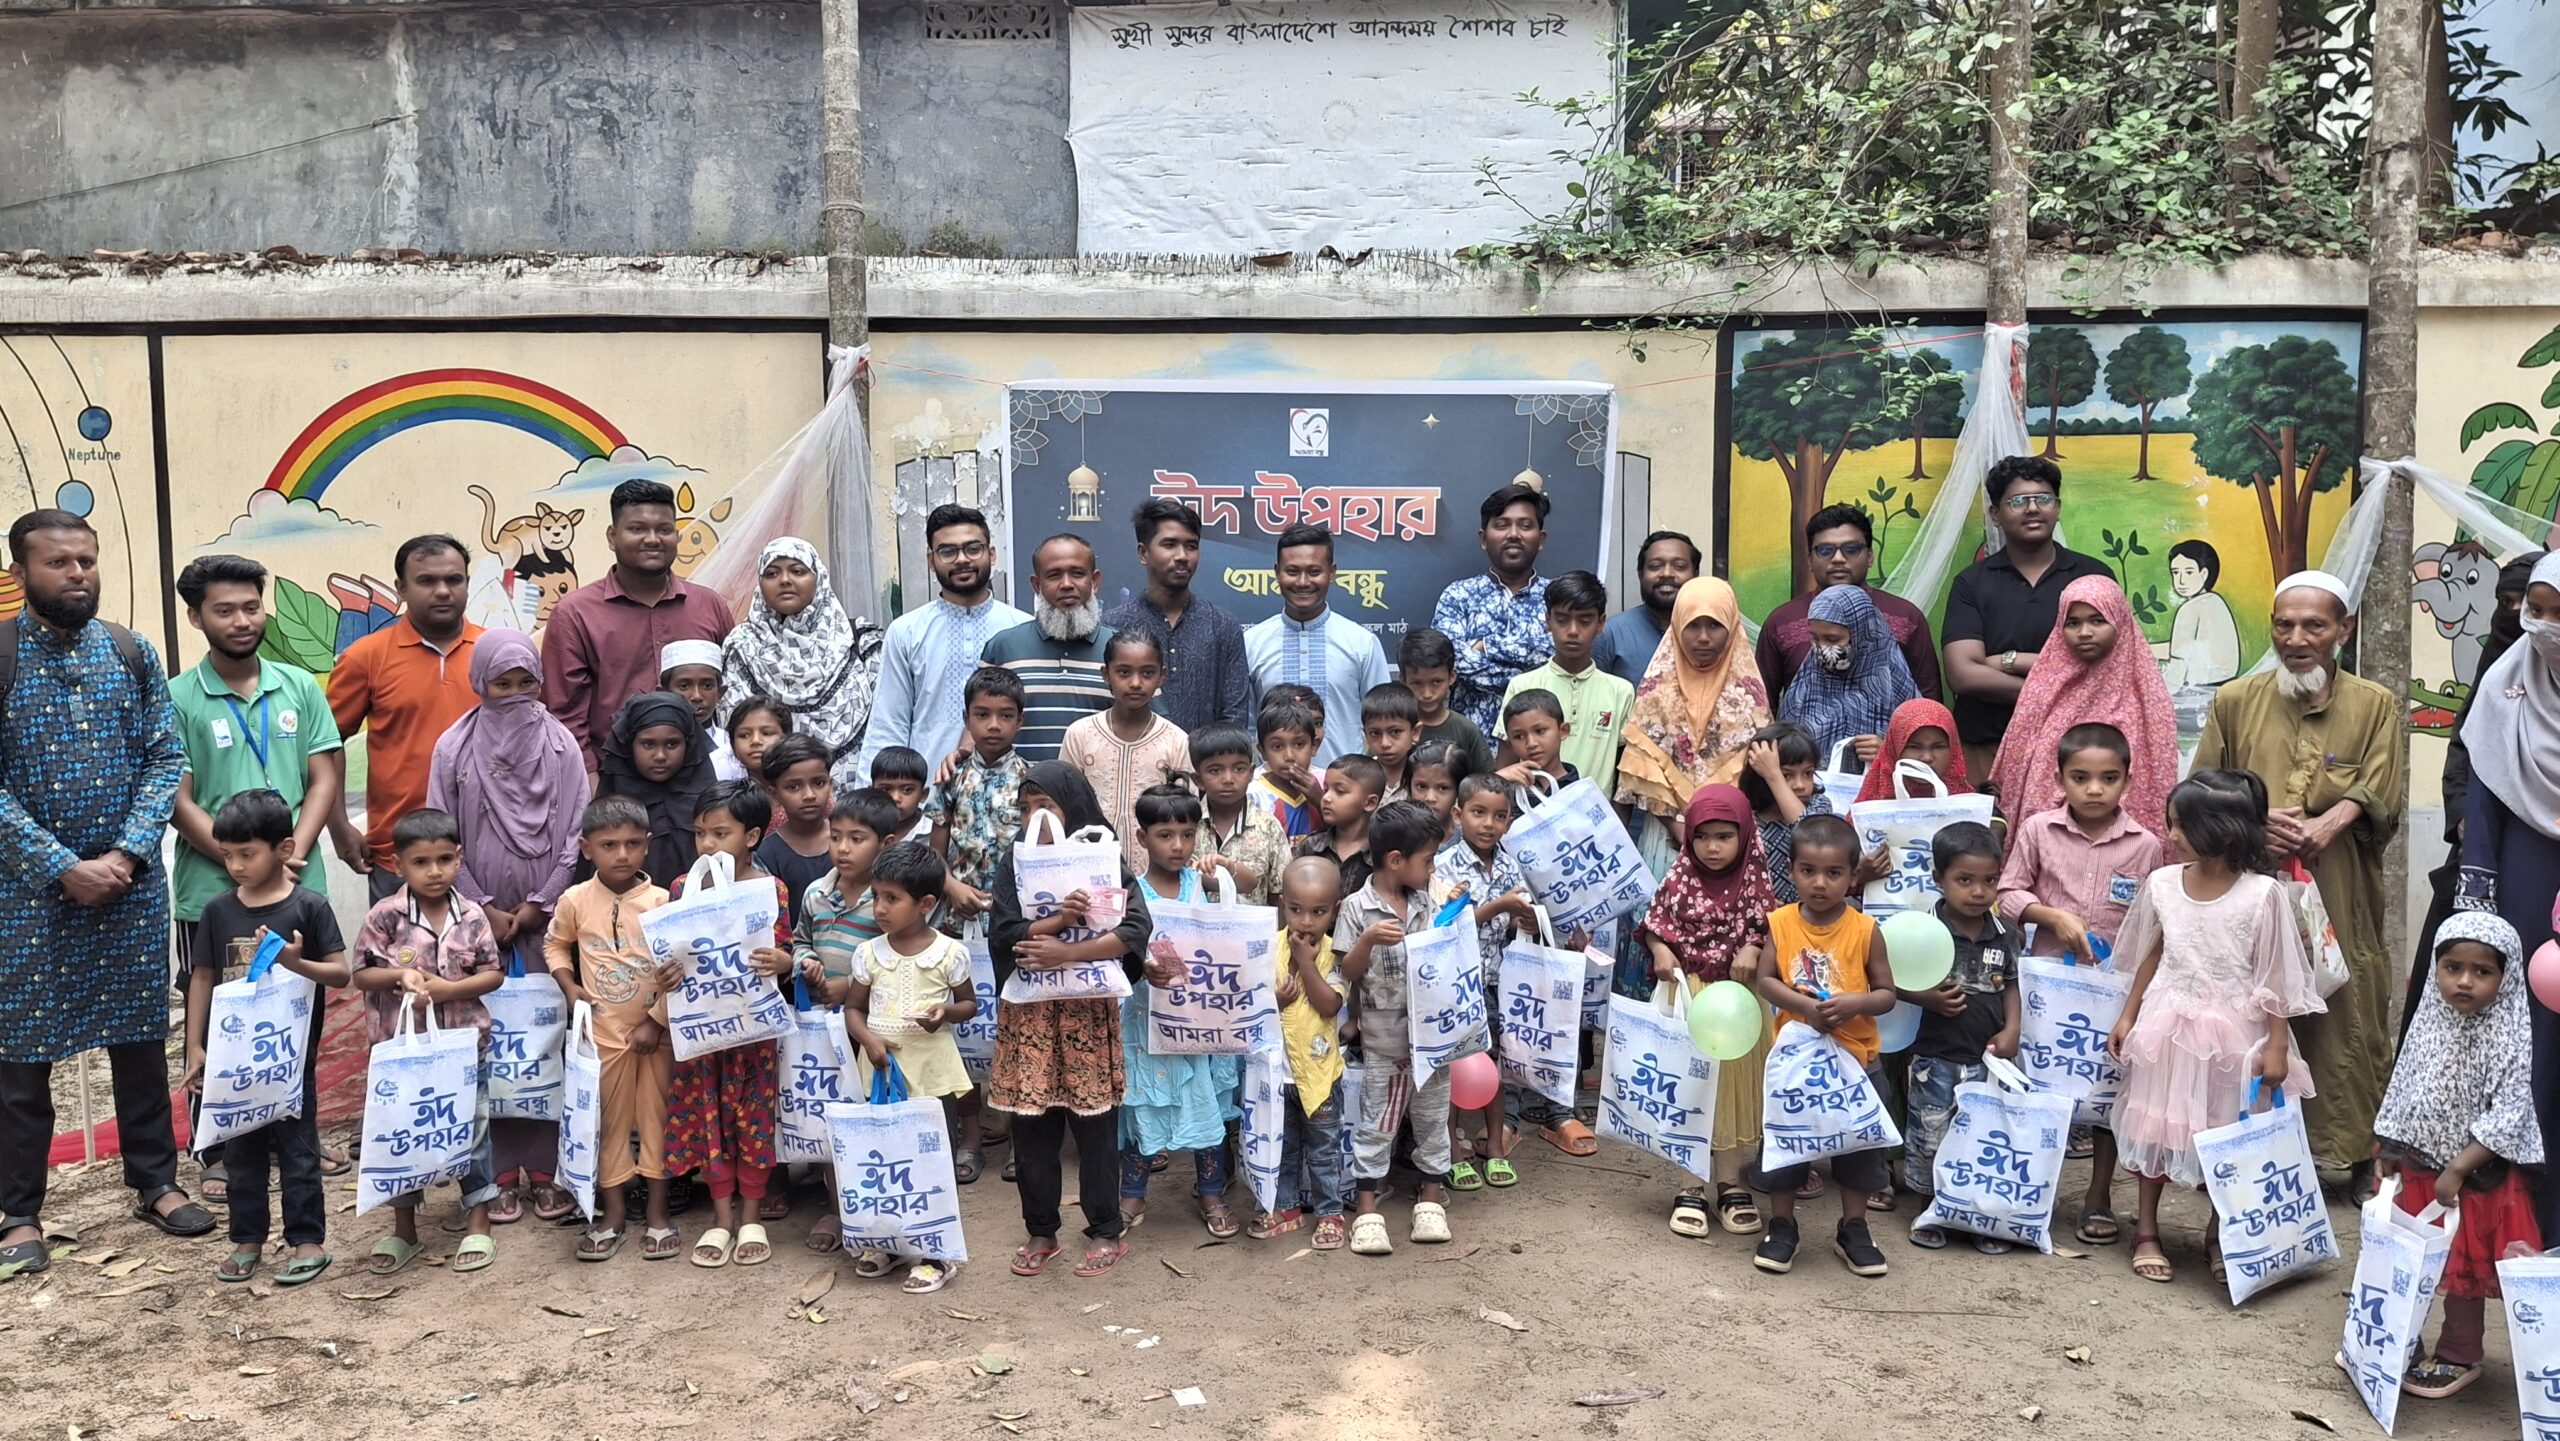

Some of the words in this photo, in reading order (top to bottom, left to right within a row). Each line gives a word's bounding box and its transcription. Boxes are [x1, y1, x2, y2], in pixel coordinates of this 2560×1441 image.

[1111, 22, 1153, 50] সুখী
[1164, 26, 1214, 48] সুন্দর
[1225, 22, 1337, 45] বাংলাদেশে
[1349, 19, 1437, 38] আনন্দময়
[1444, 14, 1517, 39] শৈশব
[1528, 12, 1569, 39] চাই
[68, 447, 121, 466] Neptune
[1252, 470, 1441, 542] উপহার
[1335, 570, 1389, 609] বন্ধু
[1387, 618, 1409, 635] মাঠ
[1552, 834, 1605, 877] ঈদ
[1900, 839, 1933, 872] ঈ
[1549, 853, 1622, 904] উপহার
[1555, 898, 1613, 934] আমরা
[1613, 878, 1645, 902] বন্ধু
[688, 937, 748, 977] ঈদ
[1072, 965, 1109, 988] বন্ধু
[1184, 950, 1241, 992] ঈদ
[680, 970, 765, 1004] উপহার
[1169, 985, 1254, 1014] উপহার
[1508, 983, 1547, 1029] ঈদ
[679, 1012, 745, 1042] আমরা
[750, 1002, 789, 1027] বন্ধু
[1159, 1022, 1224, 1044] আমরা
[1230, 1021, 1265, 1043] বন্ধু
[1438, 1000, 1486, 1034] উপহা
[253, 1021, 296, 1062] ঈদ
[792, 1053, 840, 1099] ঈদ
[1632, 1053, 1681, 1104] ঈদ
[2032, 1042, 2122, 1085] উপহার
[212, 1102, 279, 1128] আমরা
[409, 1087, 457, 1128] ঈদ
[513, 1094, 550, 1116] বন্ধু
[1614, 1074, 1689, 1127] উপহার
[1783, 1083, 1869, 1113] উপহার
[390, 1121, 474, 1156] উপহার
[1607, 1108, 1652, 1149] আমরা
[1658, 1139, 1696, 1168] বন্ধু
[1775, 1130, 1846, 1155] আমরা
[1852, 1118, 1887, 1142] বন্ধু
[857, 1150, 913, 1194] ঈদ
[1976, 1130, 2033, 1184] ঈদ
[372, 1169, 440, 1196] আমরা
[1951, 1158, 2044, 1207] উপহার
[2253, 1161, 2303, 1205] ঈদ
[840, 1188, 930, 1218] উপহার
[2243, 1187, 2316, 1237] উপহার
[905, 1230, 944, 1254] বন্ধু
[1935, 1202, 2001, 1232] আমরা
[2008, 1220, 2044, 1245] বন্ধু
[2237, 1244, 2298, 1280] আমরা
[2302, 1230, 2328, 1255] বন্ধু
